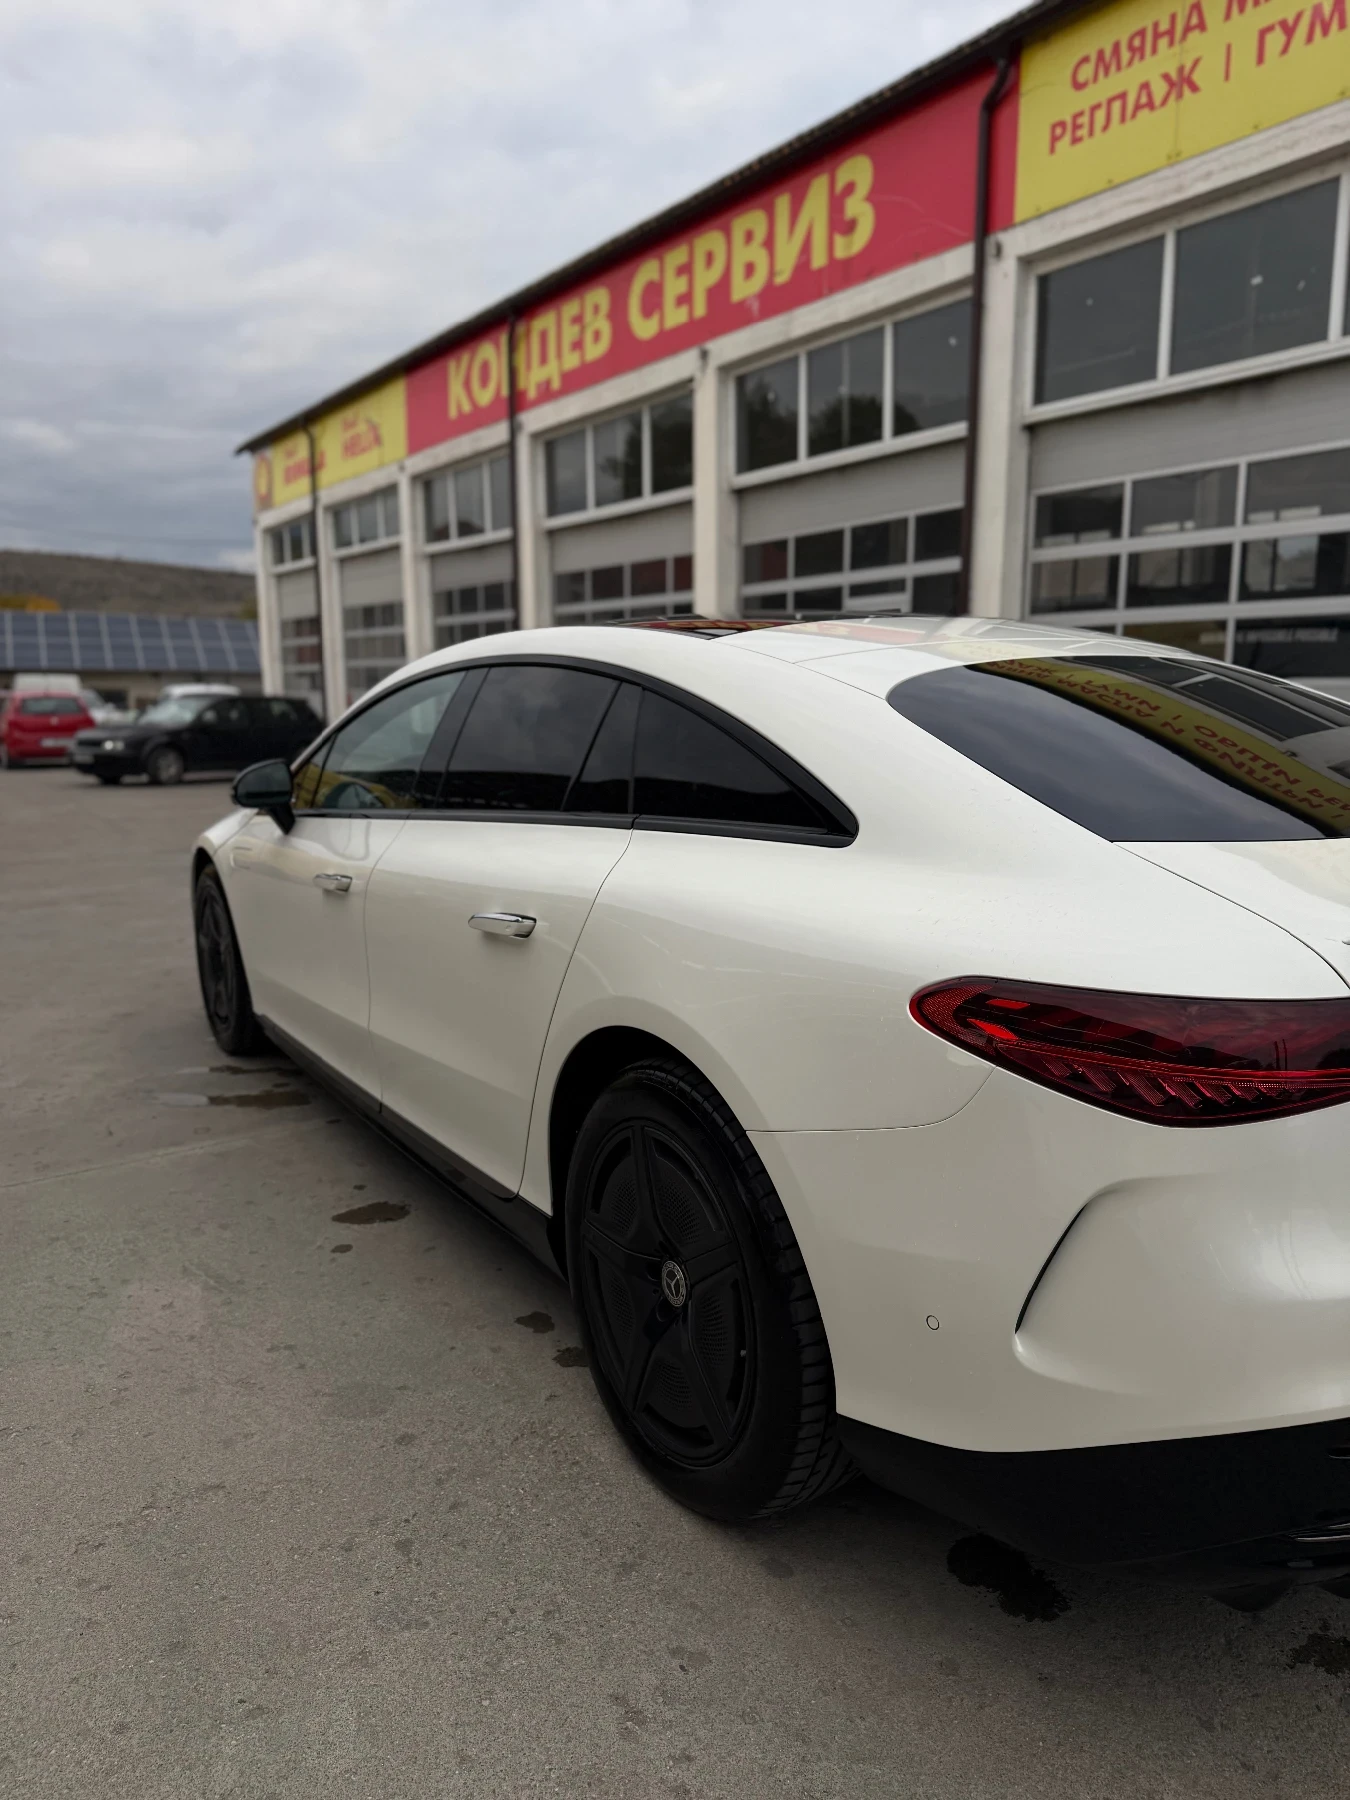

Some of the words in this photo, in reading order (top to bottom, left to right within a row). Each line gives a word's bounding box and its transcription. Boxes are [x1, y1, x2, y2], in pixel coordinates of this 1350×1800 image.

[1070, 0, 1208, 92] СМЯНА
[1049, 56, 1203, 155] РЕГЛАЖ
[448, 286, 612, 420] КОНДЕВ
[627, 153, 876, 341] СЕРВИЗ
